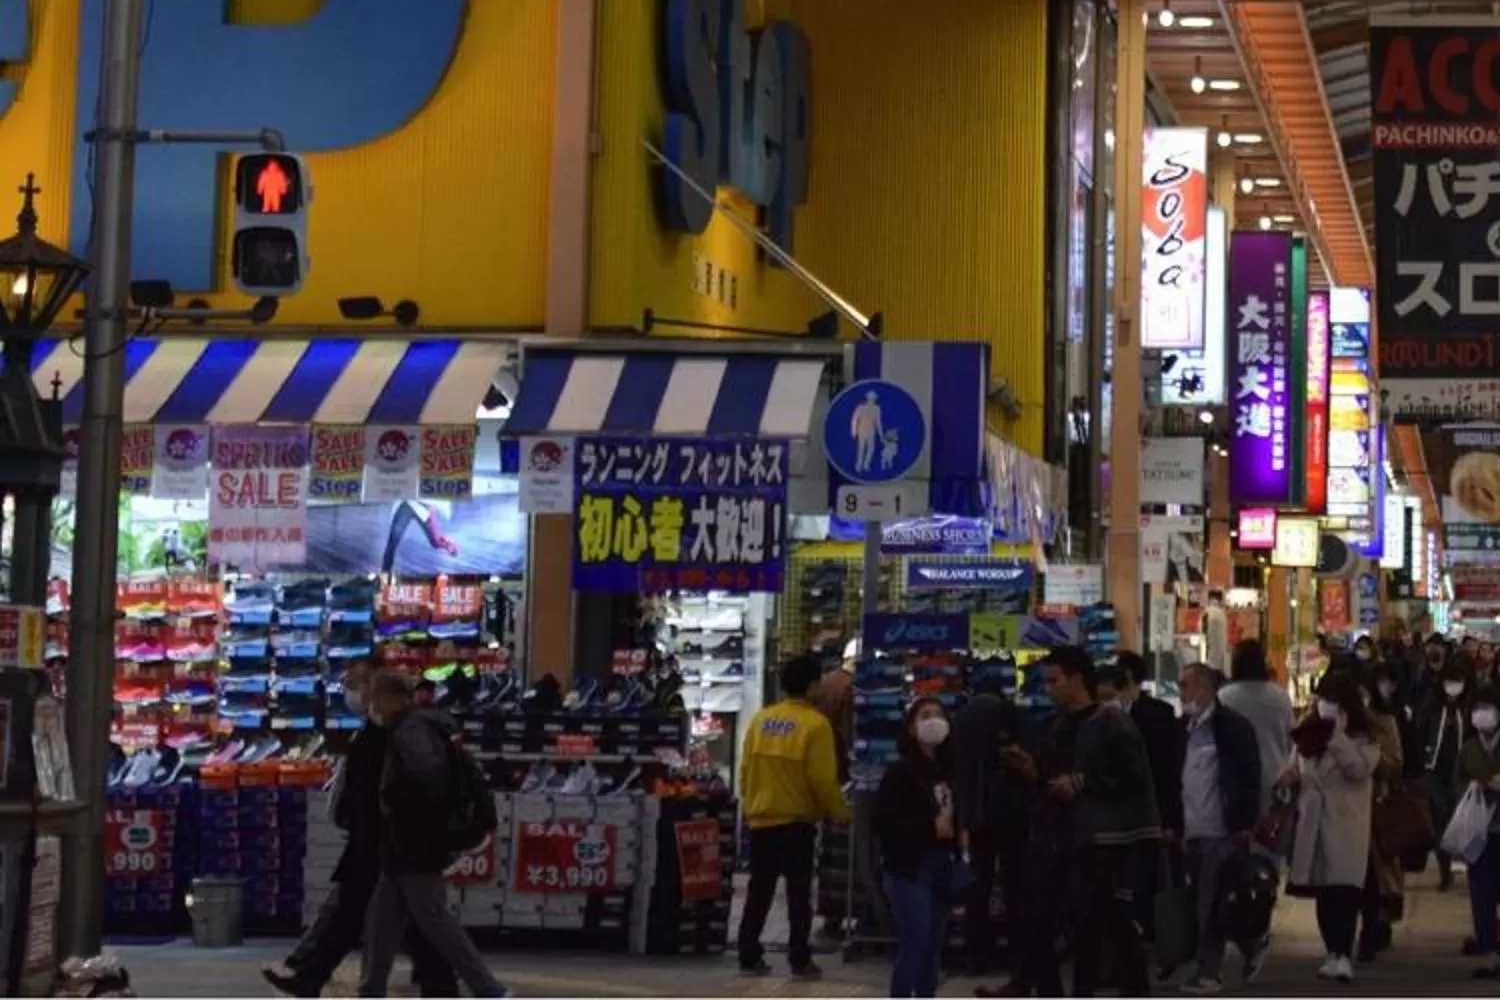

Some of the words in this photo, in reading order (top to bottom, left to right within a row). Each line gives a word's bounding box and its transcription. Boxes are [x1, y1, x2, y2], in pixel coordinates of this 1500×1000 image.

[423, 429, 471, 449] SALE
[581, 443, 670, 486] ランニング
[680, 443, 782, 487] フィットネス
[217, 472, 298, 507] SALE
[309, 476, 361, 497] Step
[421, 476, 472, 498] Step
[579, 494, 683, 563] 初心者
